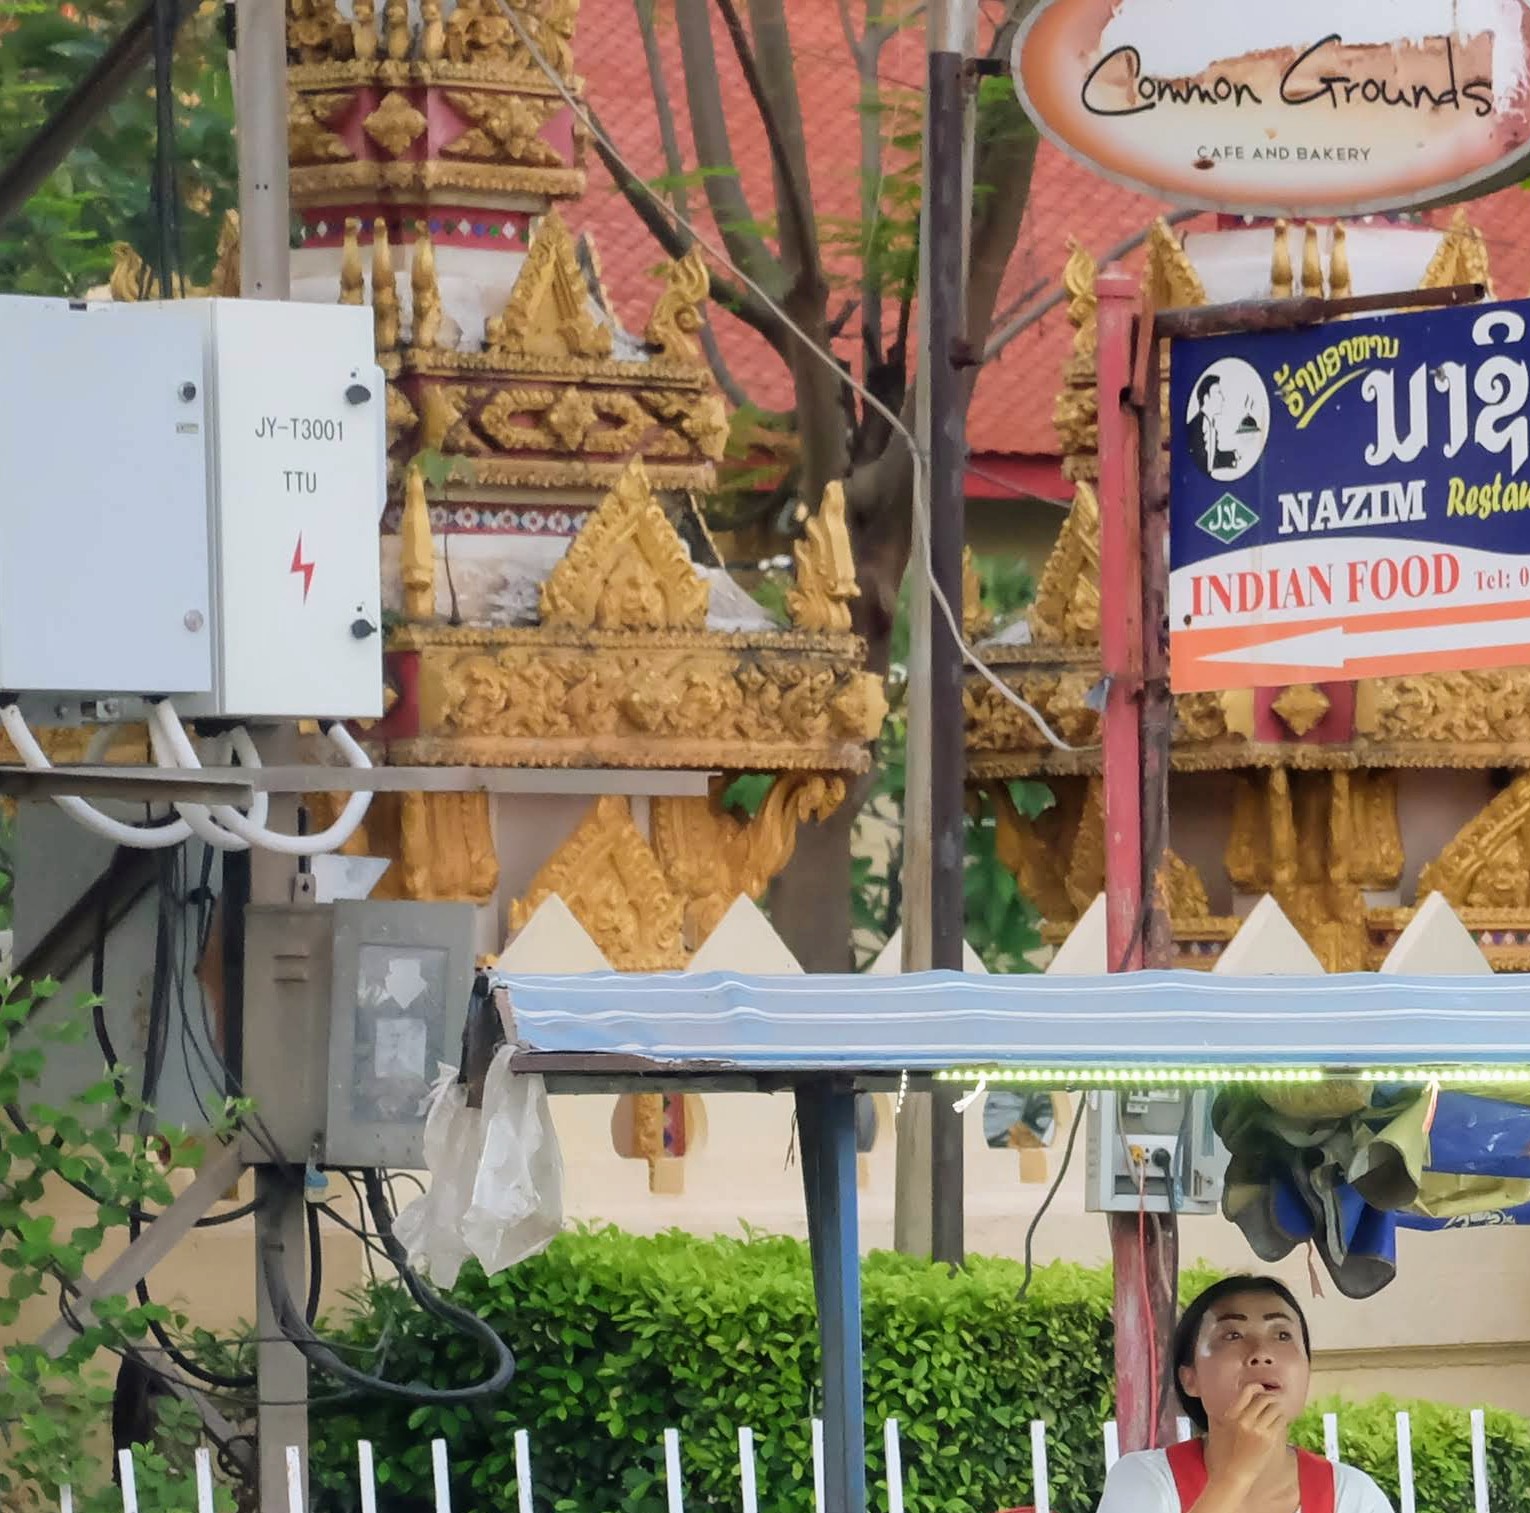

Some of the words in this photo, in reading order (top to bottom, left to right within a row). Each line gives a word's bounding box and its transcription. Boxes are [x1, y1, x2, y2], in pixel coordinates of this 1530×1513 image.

[1082, 45, 1261, 116] Common
[1280, 34, 1494, 116] Grounds
[1197, 146, 1245, 161] CAFE
[1253, 147, 1290, 161] AND
[1297, 147, 1371, 161] BAKERY
[254, 416, 344, 442] JY-T3001
[283, 470, 318, 494] TTU
[1278, 480, 1427, 534] NAZIM
[1190, 563, 1333, 617] INDIAN
[1347, 553, 1460, 604] FOOD
[1474, 569, 1511, 592] Tel:
